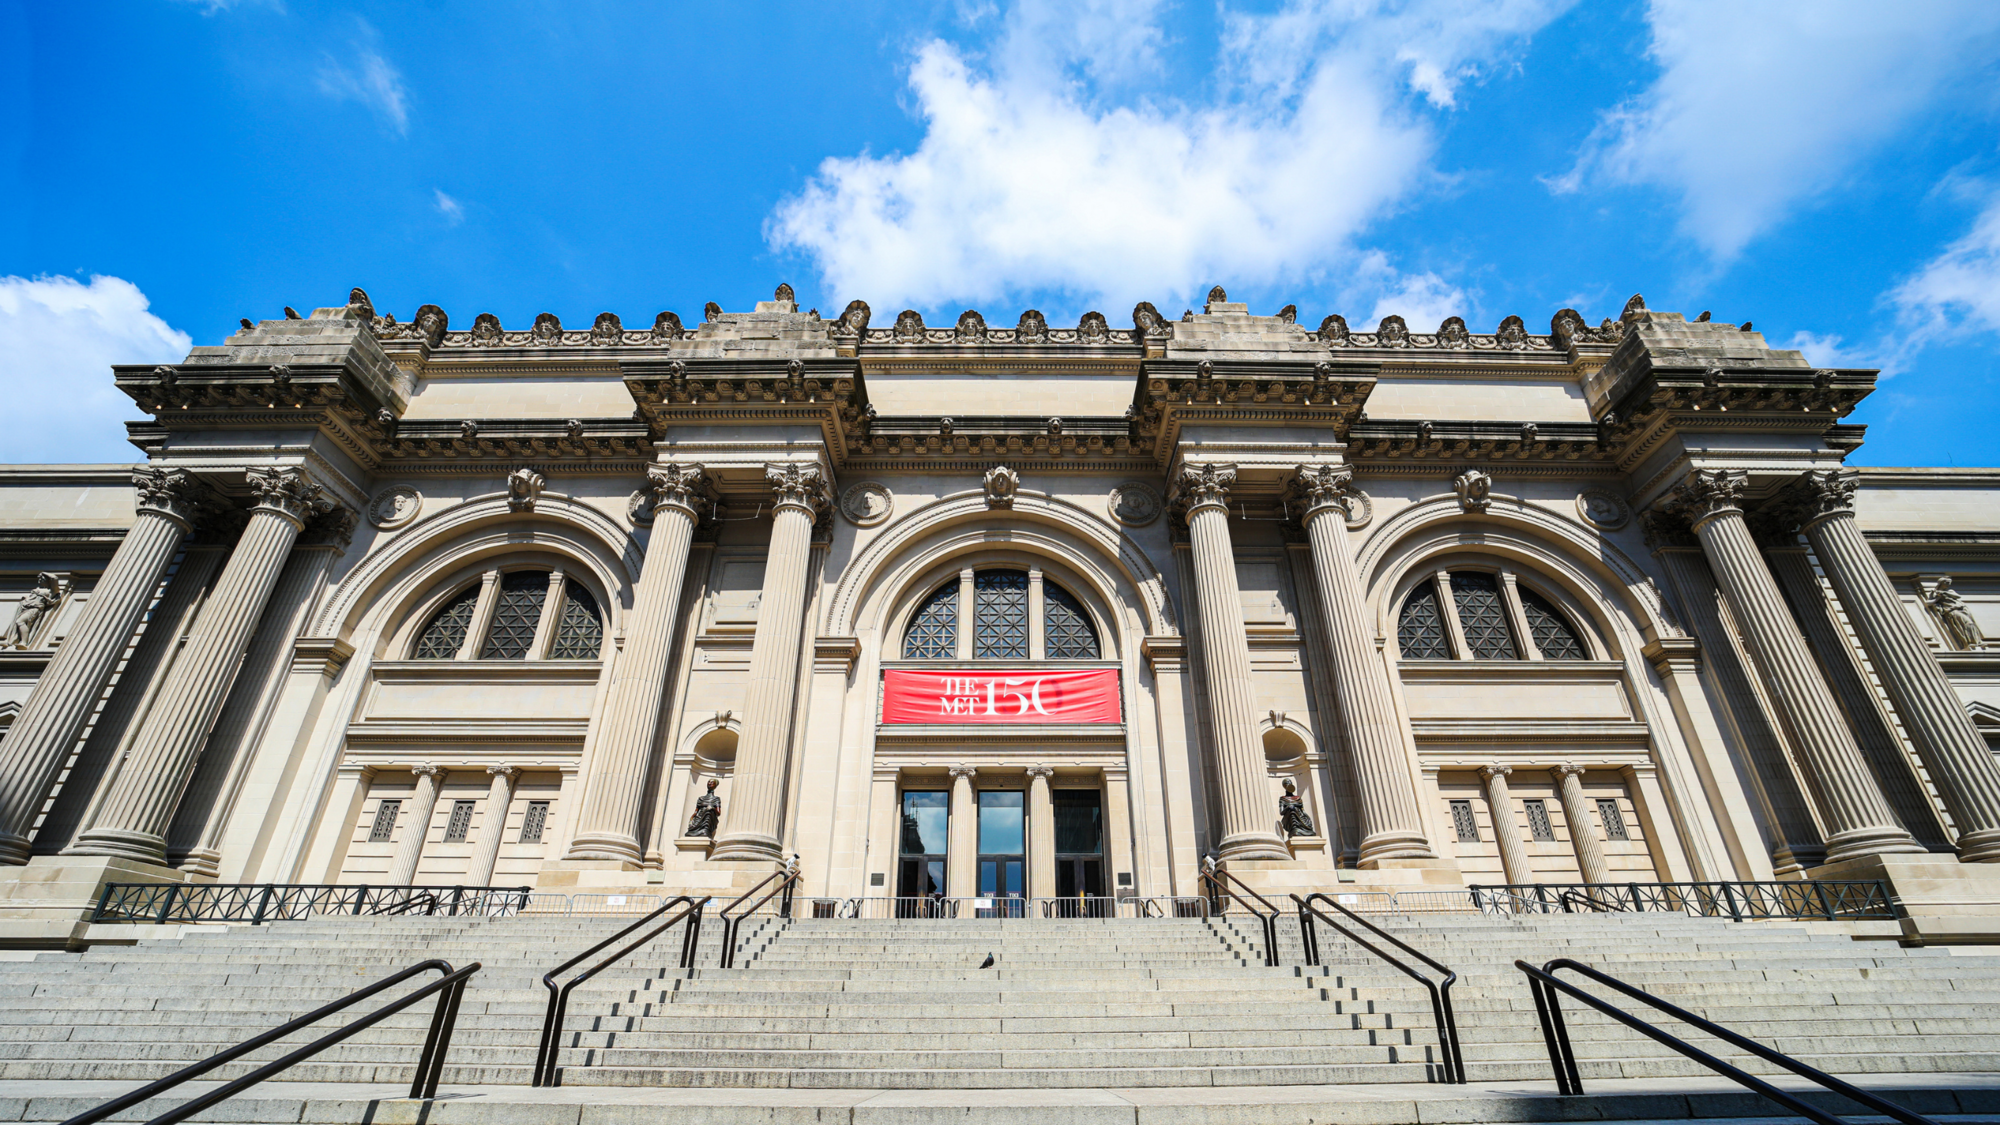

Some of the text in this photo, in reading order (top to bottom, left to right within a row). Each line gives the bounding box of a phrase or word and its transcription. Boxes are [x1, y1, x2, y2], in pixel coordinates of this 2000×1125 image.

[941, 677, 979, 695] THE
[981, 677, 1062, 716] 150
[940, 697, 979, 716] MET
